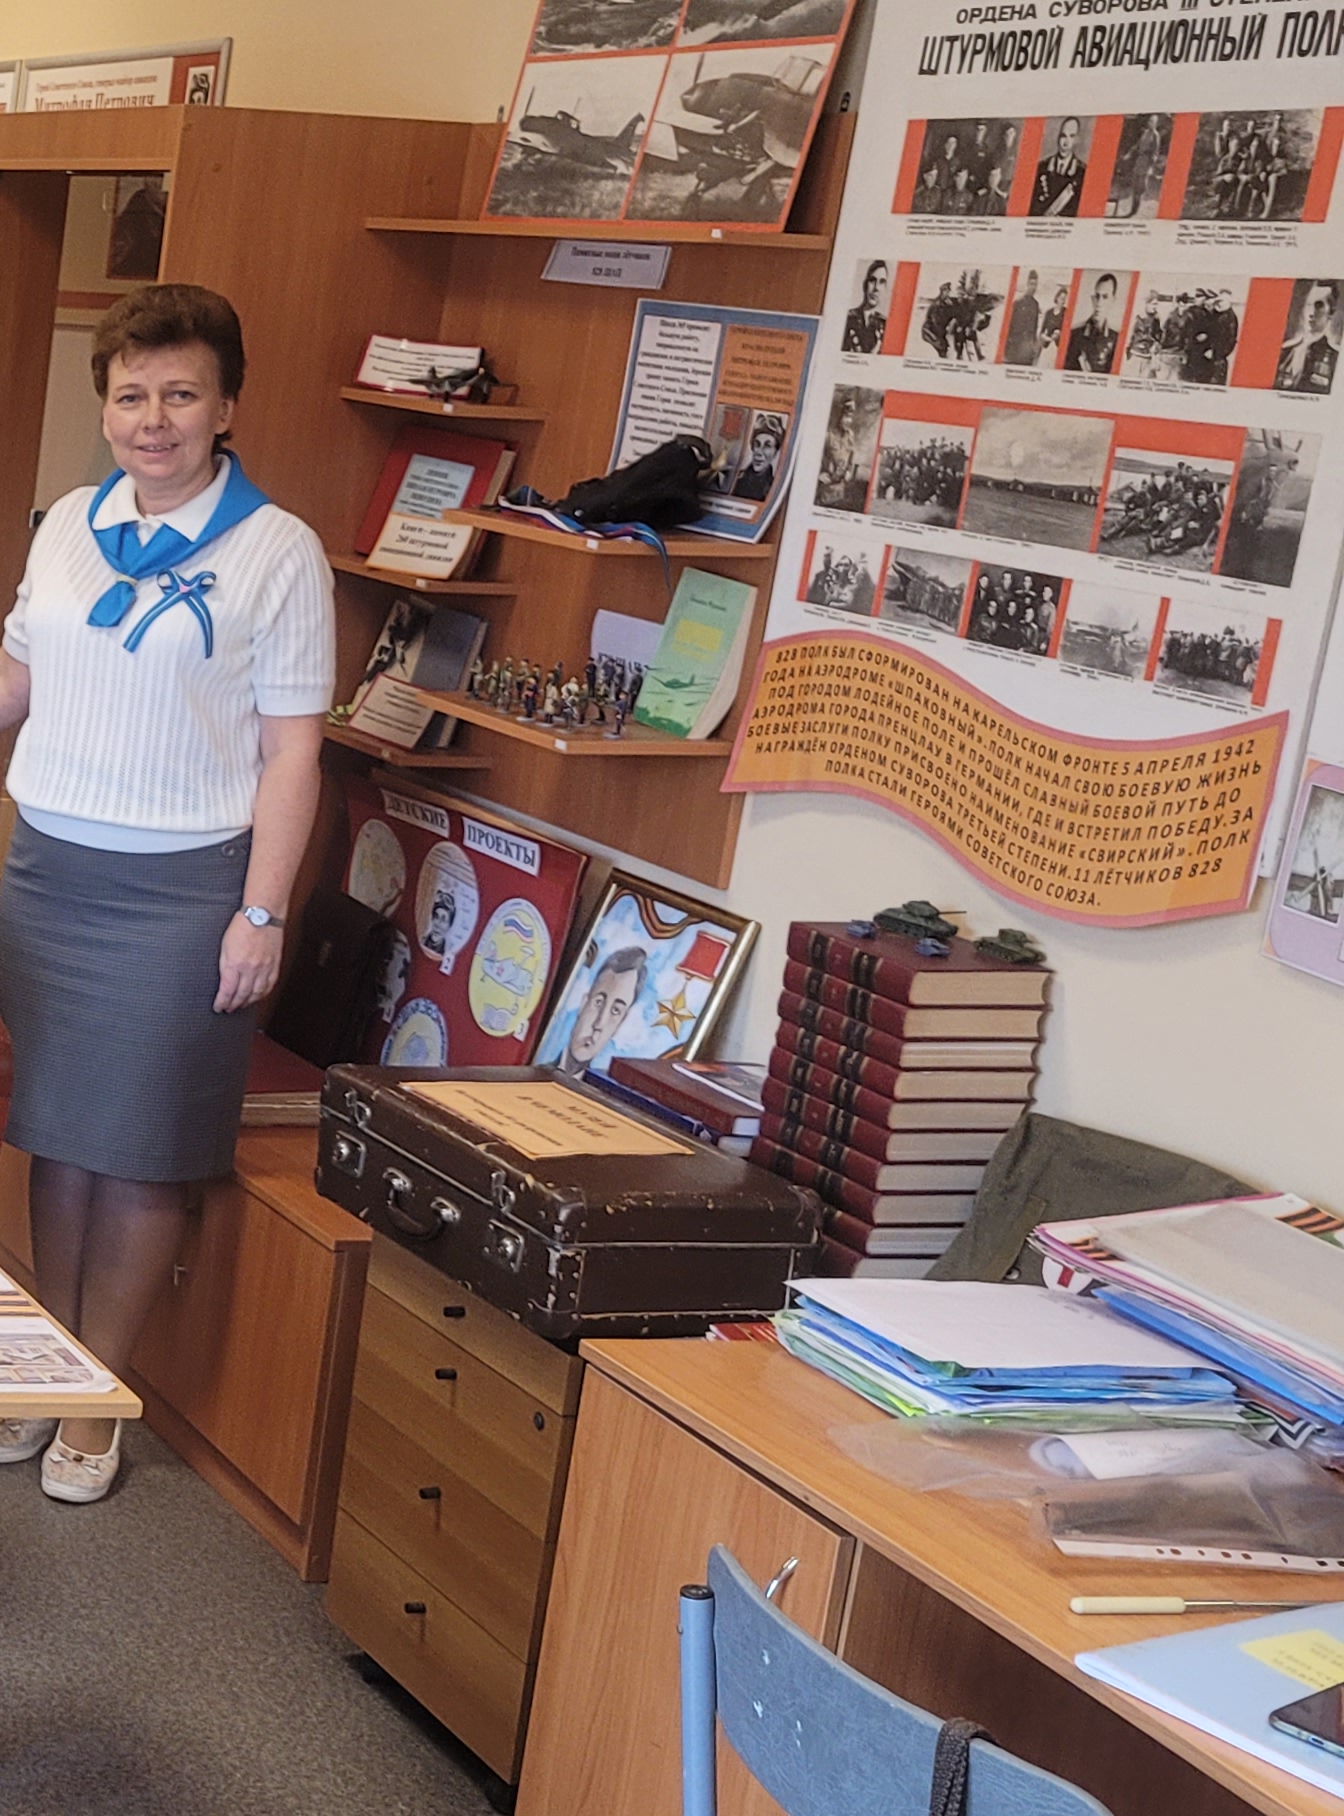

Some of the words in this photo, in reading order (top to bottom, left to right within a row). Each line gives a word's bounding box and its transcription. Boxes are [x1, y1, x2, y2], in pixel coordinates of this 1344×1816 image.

[917, 24, 1064, 76] ШТУРМОВОЙ
[1070, 11, 1268, 72] АВИАЦИОННЫЙ
[955, 6, 1038, 25] ОРДЕНА
[753, 701, 826, 720] АЭРОДРОМА
[829, 702, 876, 723] ГОРОДА
[877, 715, 943, 758] ПРЕНЦЛАУ
[1026, 807, 1053, 828] ГДЕ
[1067, 822, 1142, 842] ВСТРЕТИЛ
[763, 667, 795, 684] ГОДА
[798, 664, 812, 677] НА
[814, 663, 886, 688] АЭРОДРОМЕ
[1025, 759, 1072, 790] НАЧАЛ
[1074, 774, 1114, 797] СВОЮ
[1118, 777, 1192, 798] БОЕВУЮ
[1196, 759, 1263, 790] ЖИЗНЬ
[768, 685, 795, 701] ПОД
[797, 682, 852, 698] ГОРОДОМ
[853, 686, 920, 724] ЛОДЕЙНОЕ
[922, 716, 956, 748] ПОЛЕ
[1023, 782, 1090, 816] СЛАВНЫЙ
[1093, 800, 1156, 820] БОЕВОЙ
[1161, 796, 1210, 817] ПУТЬ
[1214, 787, 1242, 808] ДО
[775, 648, 797, 664] 828
[800, 645, 829, 659] ПОЛК
[831, 645, 855, 659] БЫЛ
[857, 649, 950, 700] СФОРМИРОВАН
[953, 696, 970, 716] НА
[972, 708, 1059, 763] КАРЕЛЬСКОМ
[1062, 753, 1119, 776] ФРОНТЕ
[1134, 752, 1207, 776] АПРЕЛЯ
[1212, 739, 1256, 764] 1942
[387, 796, 448, 830] ДЕТСКИЕ
[467, 824, 536, 868] ПРОЕКТЫ
[747, 720, 798, 738] БОЕВЫЕ
[800, 720, 849, 737] ЗАСЛУГИ
[851, 725, 892, 748] ПОЛКУ
[893, 740, 968, 797] ПРИСВОЕНО
[970, 790, 1077, 859] НАИМЕНОВАНИЕ
[825, 759, 866, 780] ПОЛКА
[868, 769, 908, 796] СТАЛИ
[910, 790, 965, 841] ГЕРОЯМИ
[966, 833, 1044, 892] СОВЕТСКОГО
[1045, 882, 1102, 907] СОЮЗА.
[830, 740, 887, 767] ОРДЕНОМ
[889, 758, 954, 811] СУВОРОВА
[956, 801, 1007, 849] ТРЕТЬЕЙ
[1188, 857, 1224, 879] 828
